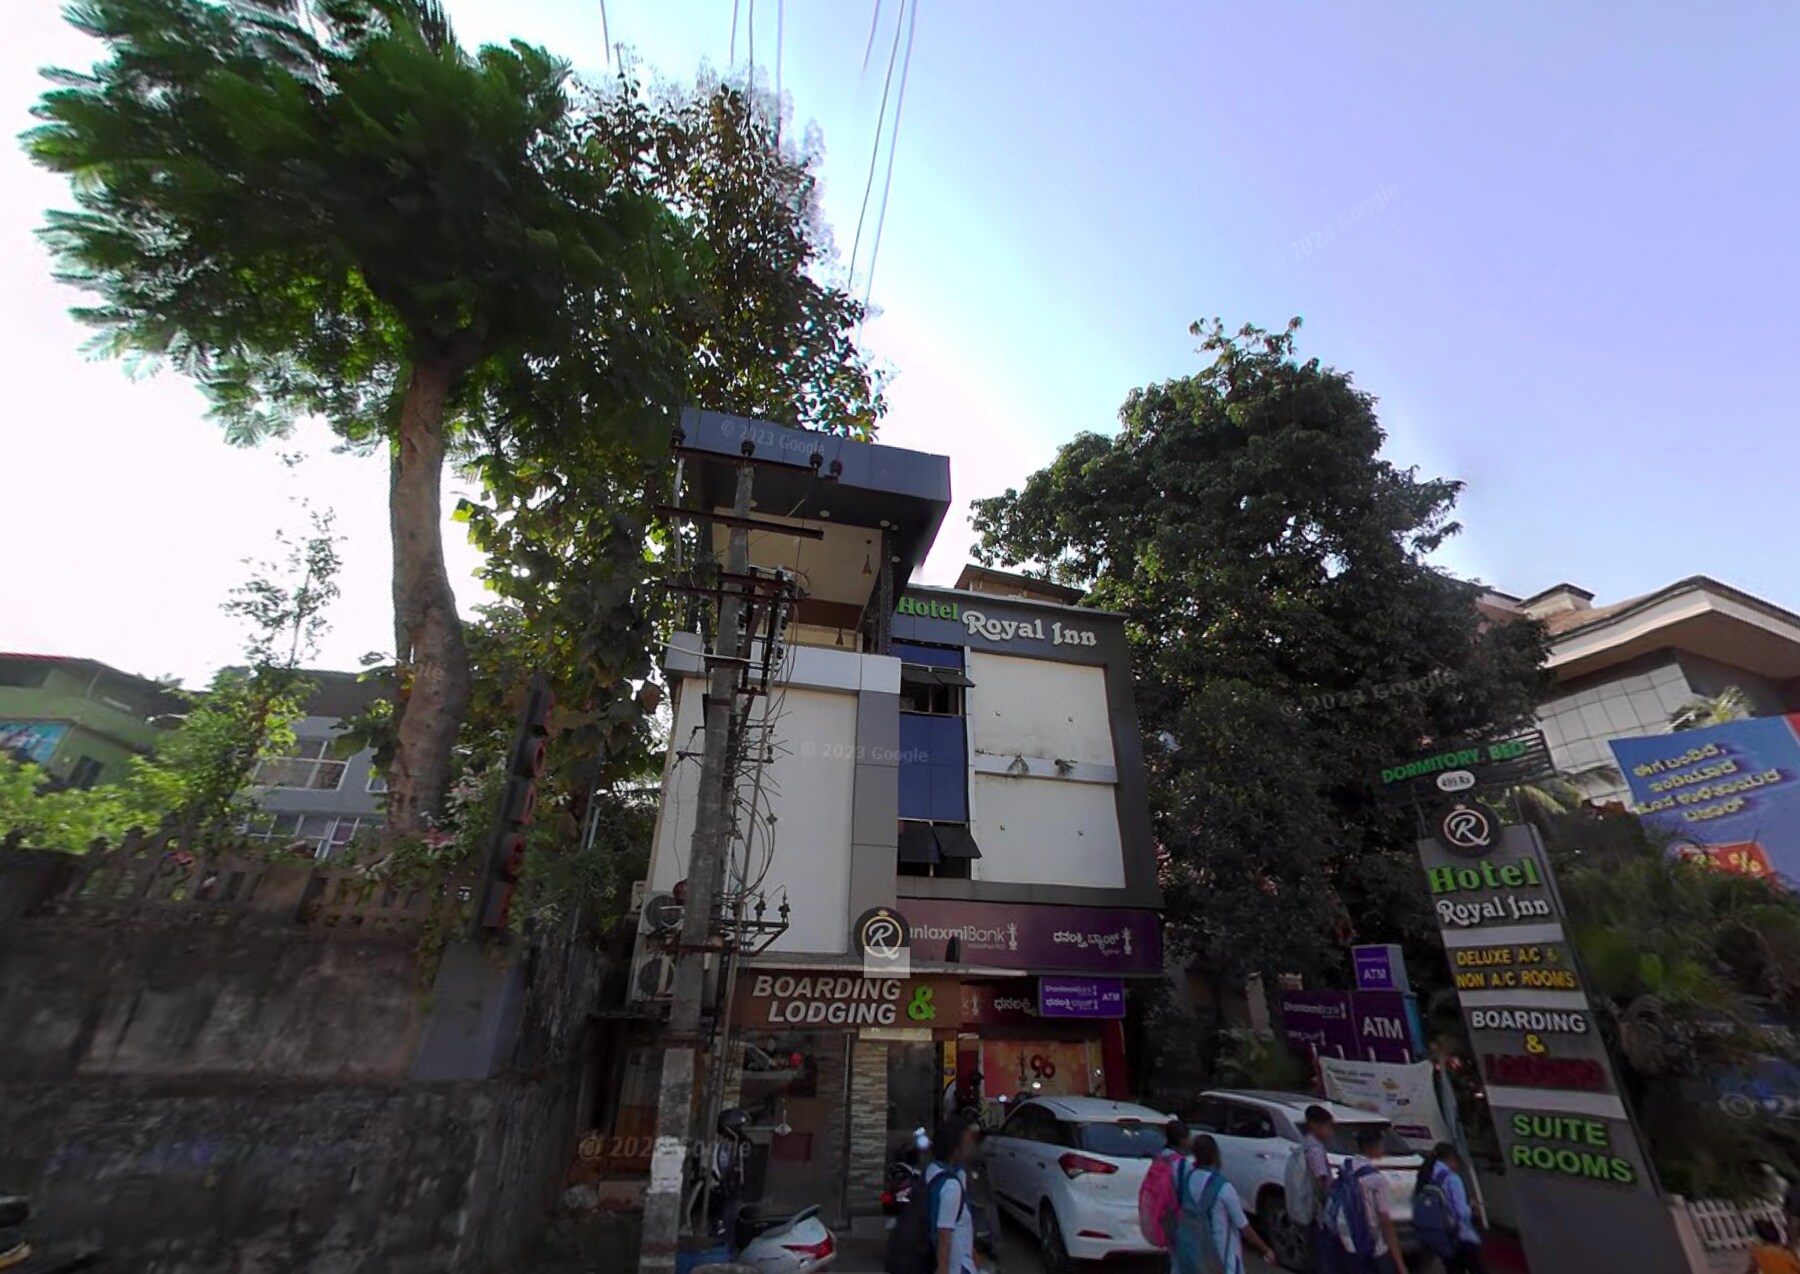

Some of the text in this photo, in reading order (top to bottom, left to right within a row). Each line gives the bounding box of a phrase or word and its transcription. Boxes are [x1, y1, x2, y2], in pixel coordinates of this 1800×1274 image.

[897, 597, 1097, 647] Hotel Royal Inn
[1381, 740, 1528, 784] DORMITORY BED
[1427, 858, 1542, 893] Hotel
[1436, 895, 1549, 926] Royal Inn
[1456, 949, 1513, 967] DELUXE
[1364, 968, 1387, 981] ATM
[1456, 972, 1486, 989] NON
[1521, 971, 1576, 988] ROOMS
[753, 975, 901, 1000] BOARDING
[1102, 993, 1121, 1002] ATM
[768, 1000, 897, 1025] LODGING
[907, 984, 937, 1020] &
[1363, 1016, 1404, 1040] ATM
[1472, 1010, 1587, 1033] BOARDING
[1526, 1034, 1545, 1054] &
[1513, 1114, 1608, 1146] SUITE
[1512, 1145, 1633, 1183] ROOMS
